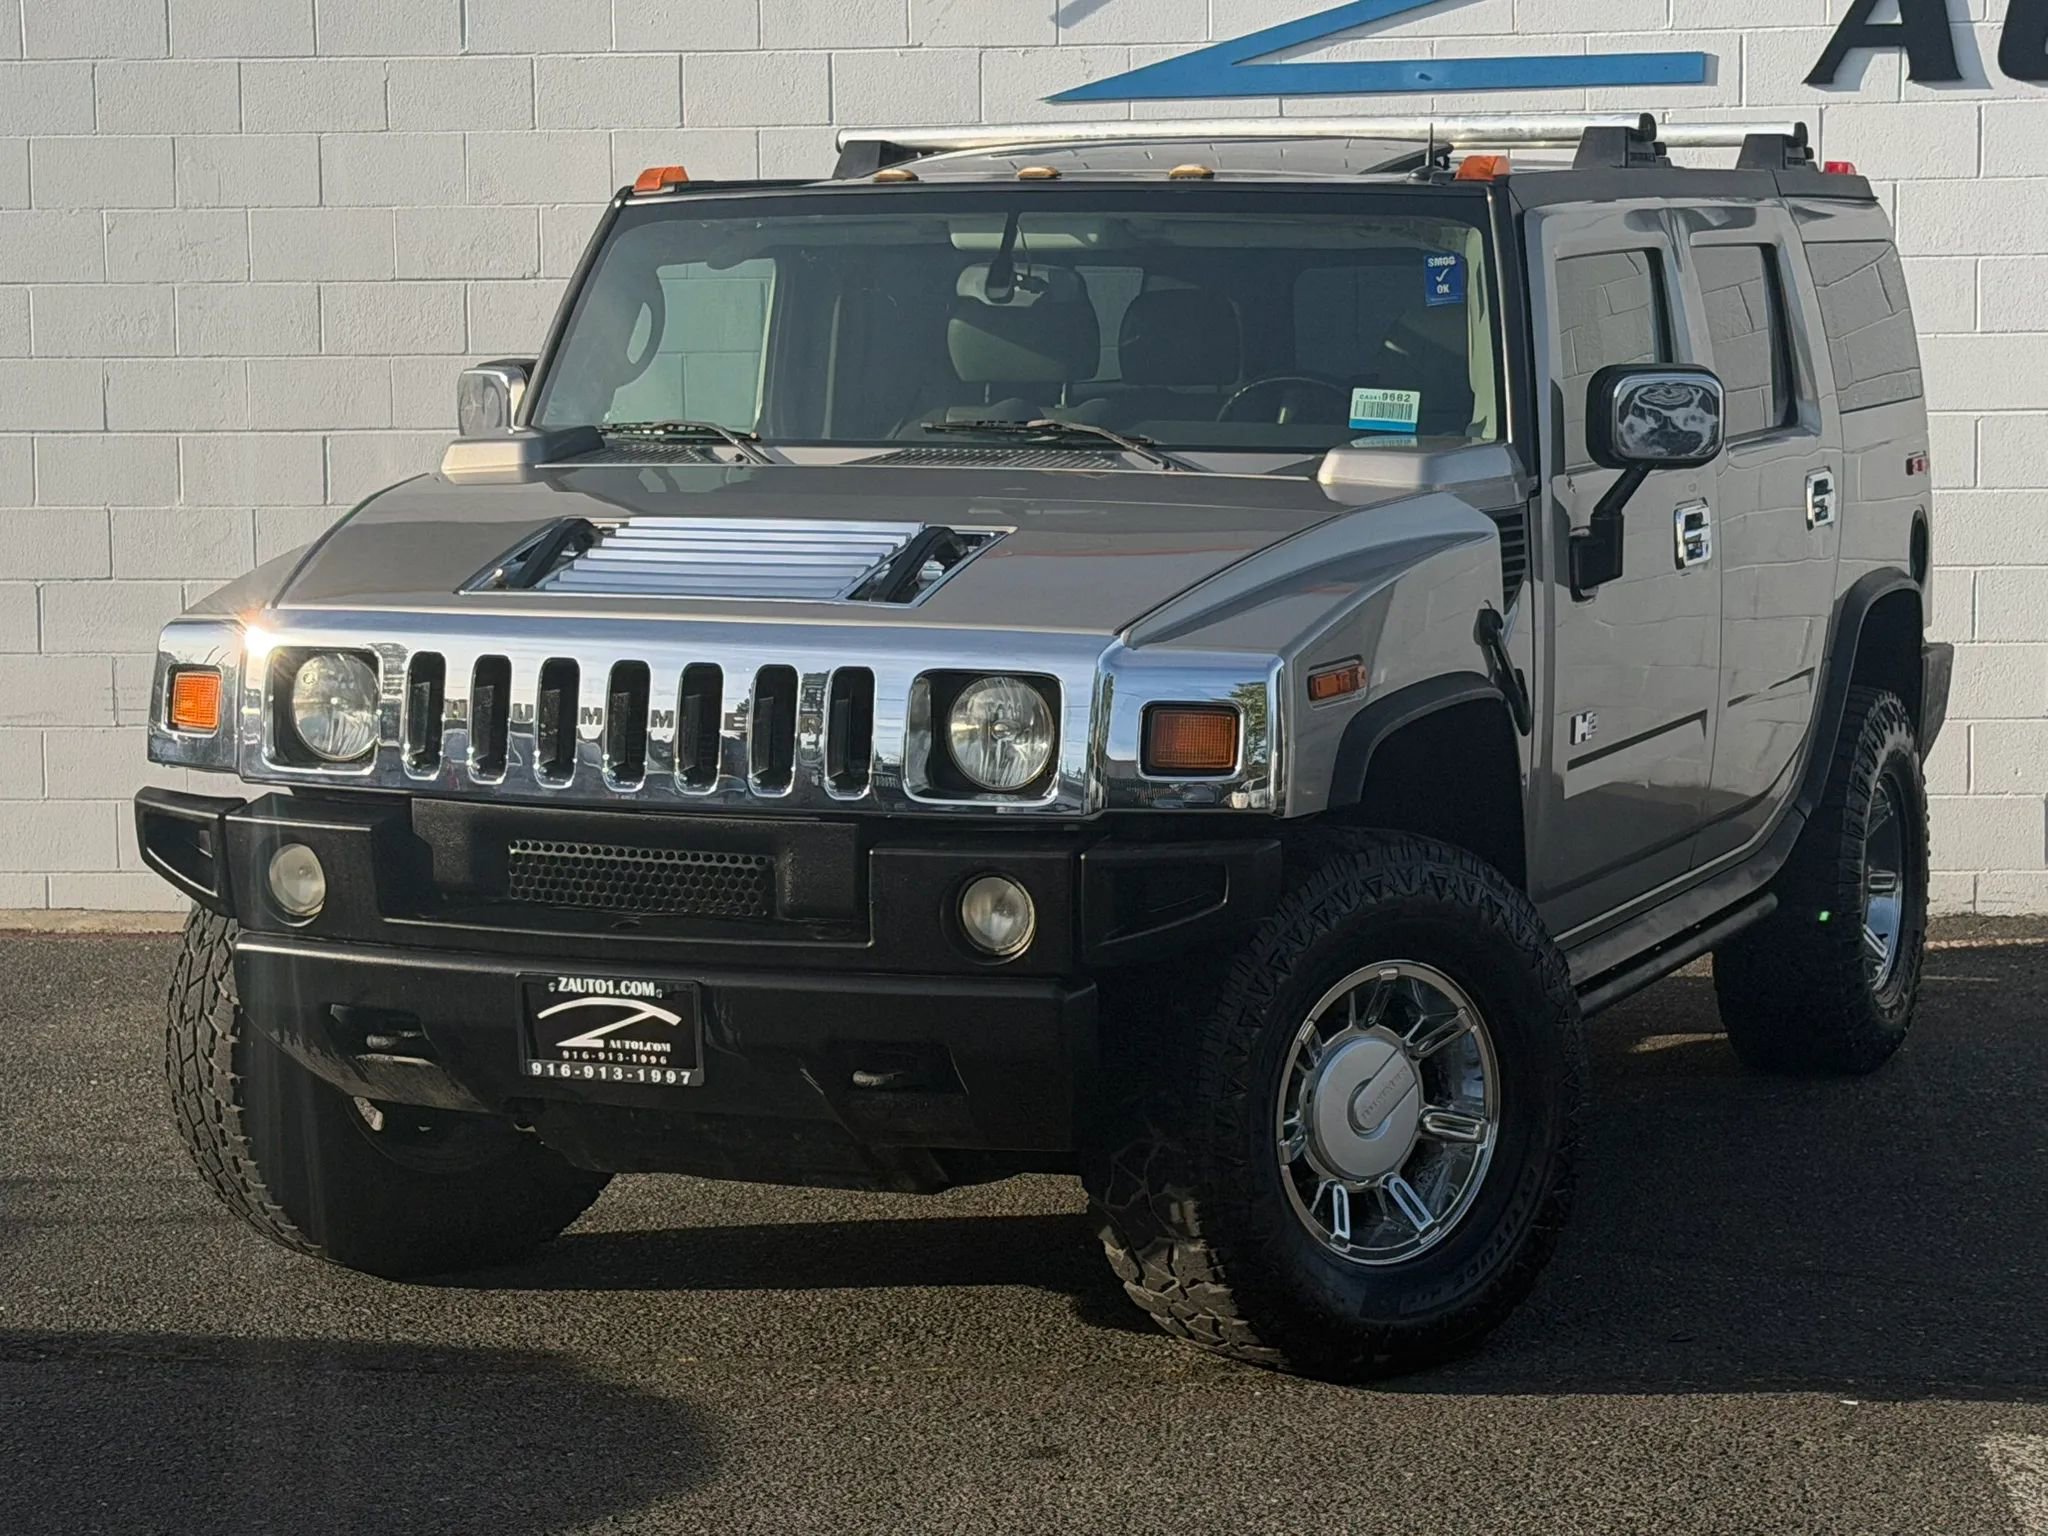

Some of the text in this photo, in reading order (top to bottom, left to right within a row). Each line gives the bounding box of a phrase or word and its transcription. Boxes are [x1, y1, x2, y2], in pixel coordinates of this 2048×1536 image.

[1427, 256, 1456, 268] SMOG
[1436, 284, 1450, 294] OK
[557, 976, 656, 997] ZAUTO1.COM
[531, 1062, 691, 1086] 916-913-1997
